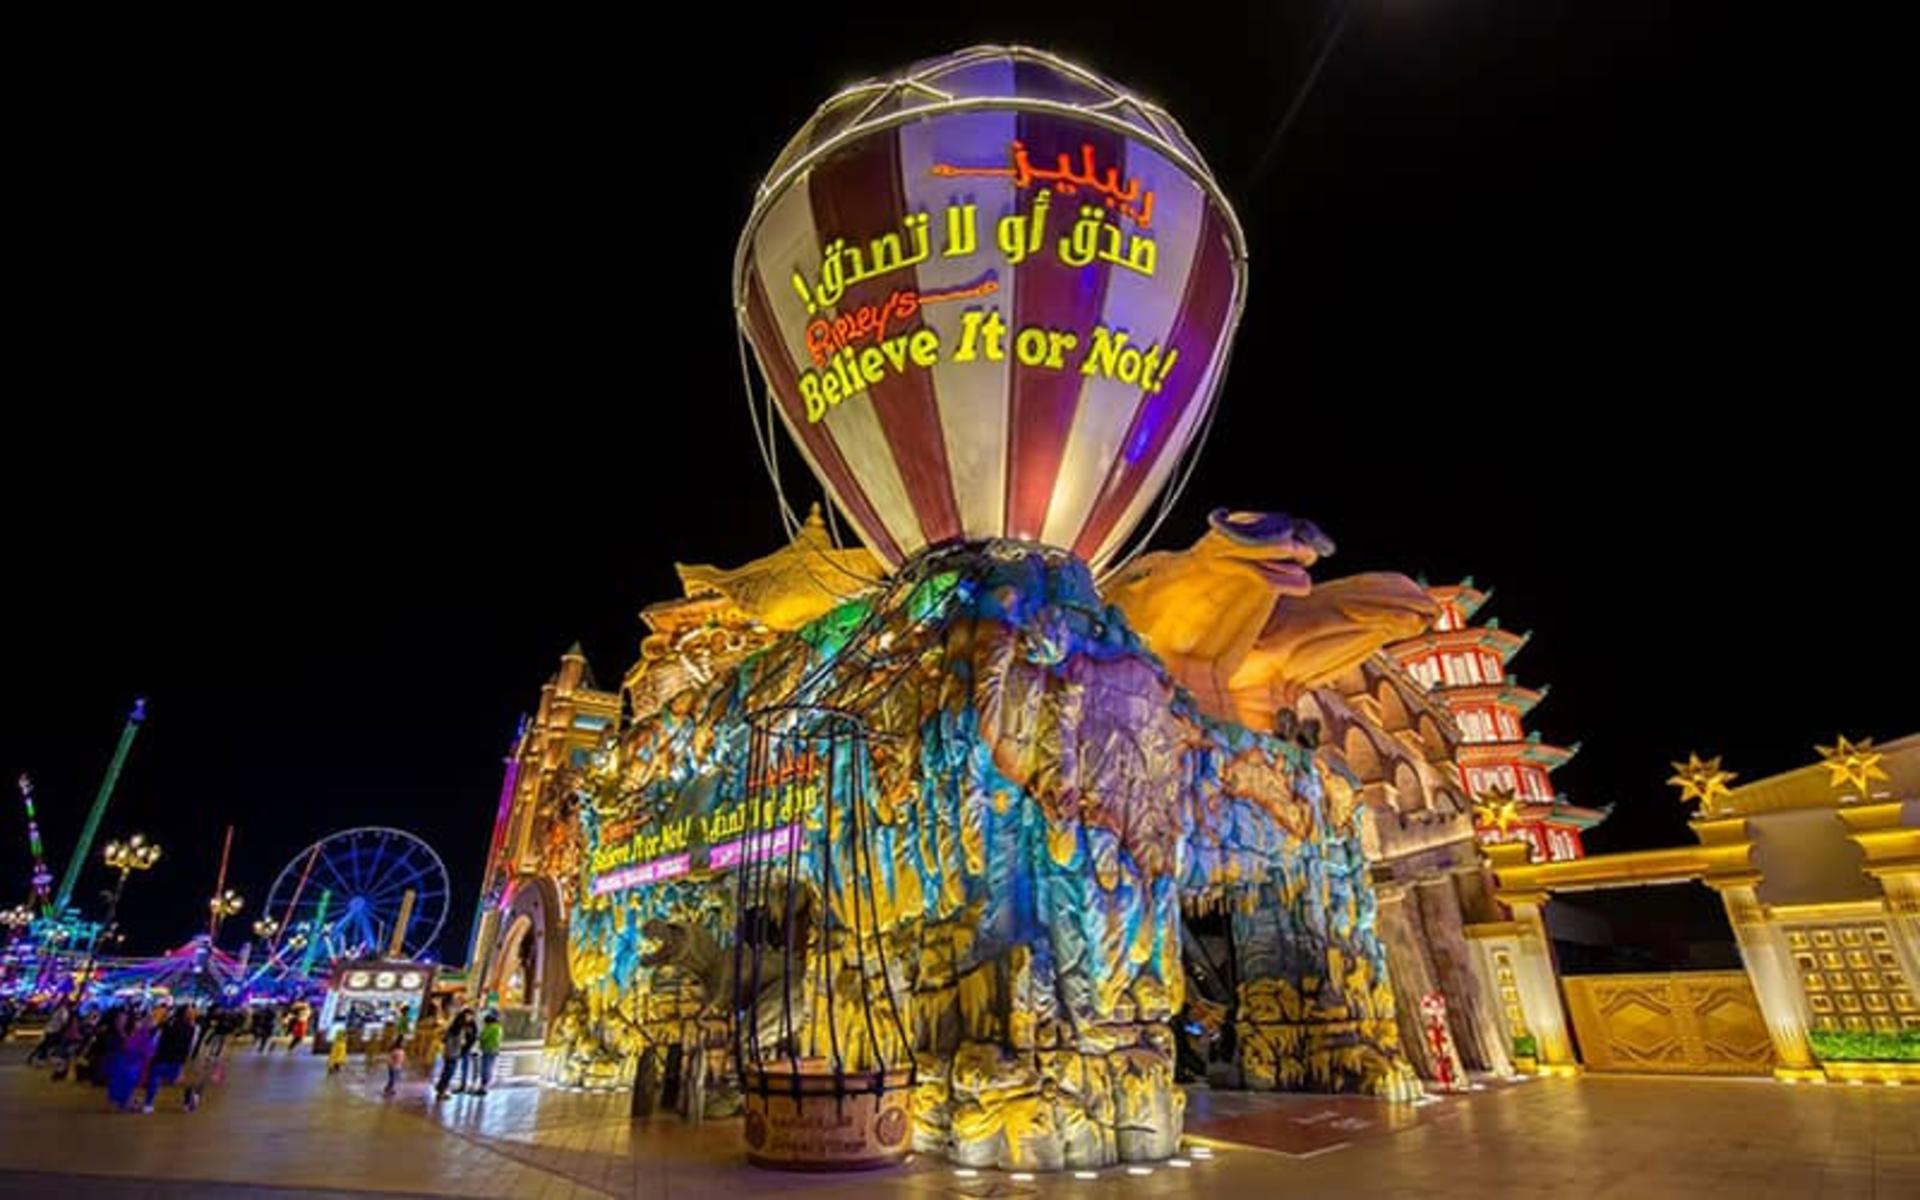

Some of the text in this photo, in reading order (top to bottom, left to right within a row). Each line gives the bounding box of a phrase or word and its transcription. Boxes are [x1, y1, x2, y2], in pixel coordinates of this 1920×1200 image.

[943, 203, 978, 258] لا
[998, 189, 1051, 265] أو
[1058, 204, 1158, 276] صدق
[799, 310, 1180, 424] Believe It or Not!
